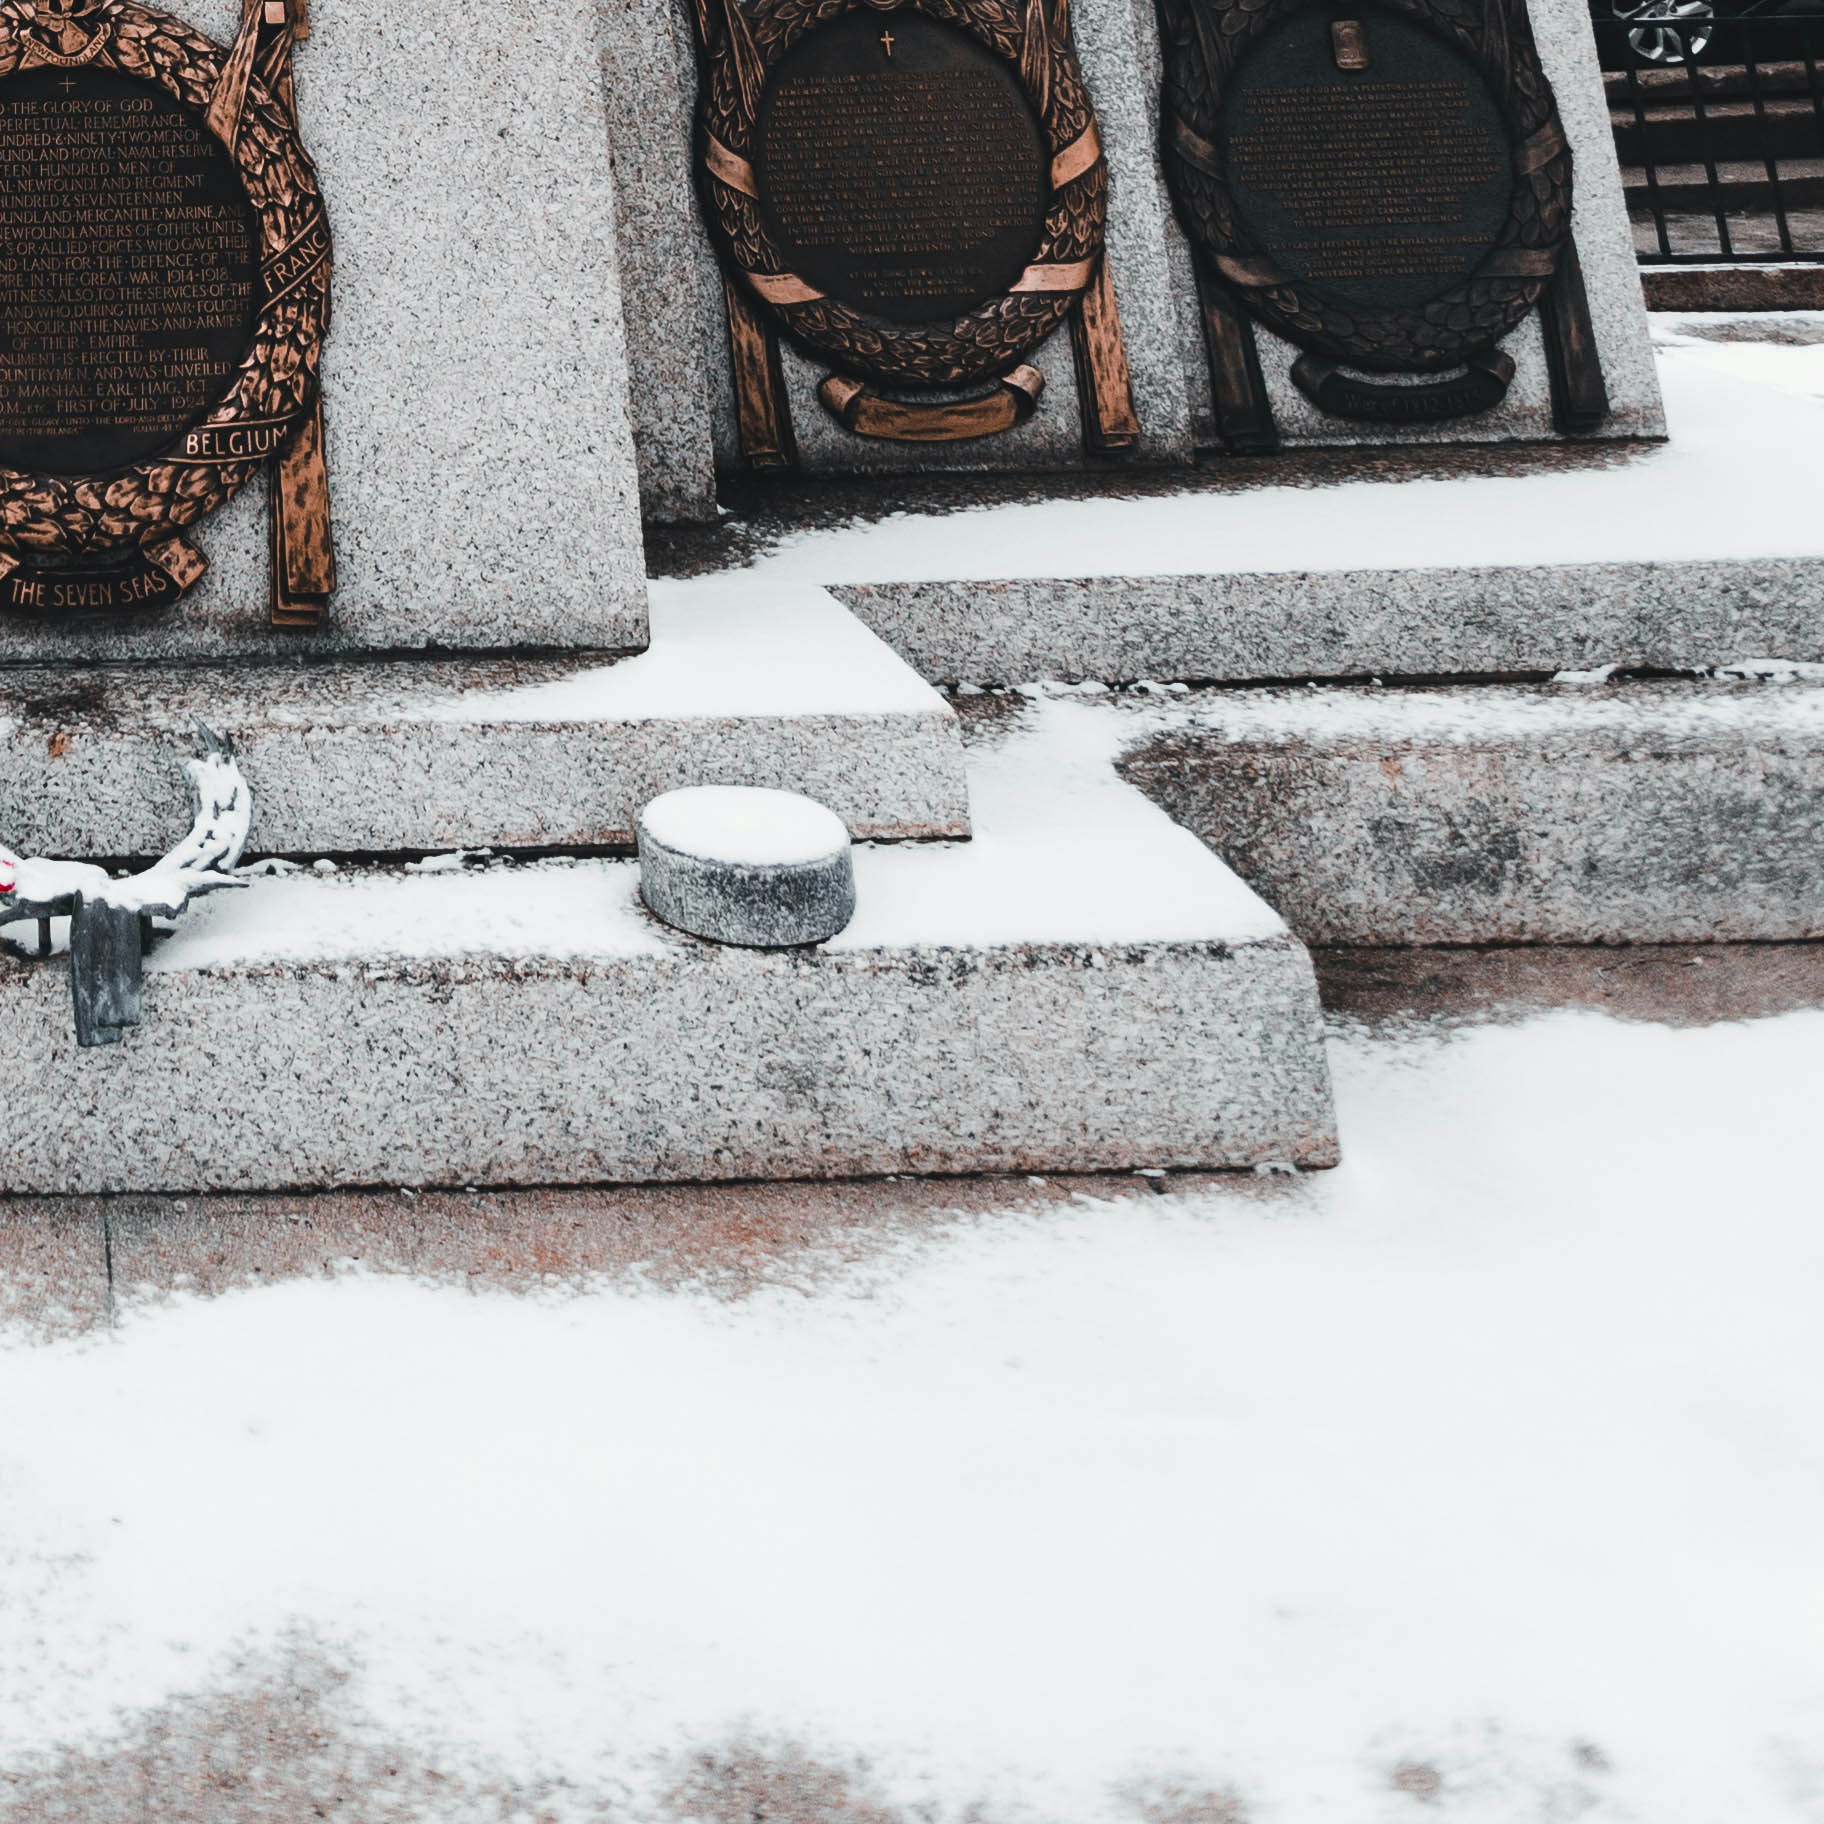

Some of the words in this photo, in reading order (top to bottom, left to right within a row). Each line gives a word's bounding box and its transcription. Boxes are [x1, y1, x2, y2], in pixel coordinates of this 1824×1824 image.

[24, 35, 107, 66] NEWFOUNDLAND
[11, 101, 35, 114] THE
[43, 100, 90, 114] GLORY
[94, 99, 111, 113] OF
[120, 98, 153, 112] GOD
[85, 113, 186, 129] REMEMBRANCE
[120, 130, 150, 144] TWO
[154, 129, 182, 143] MEN
[185, 129, 200, 142] OF
[73, 146, 113, 160] ROYAL
[118, 145, 158, 159] NAVAL
[40, 162, 109, 176] HUNDRED
[119, 161, 150, 174] MEN
[159, 160, 174, 174] OF
[17, 176, 131, 192] NEWFOUNDLAND
[136, 174, 204, 190] REGIMENT
[74, 191, 152, 206] SEVENTEEN
[156, 190, 183, 205] MEN
[76, 207, 159, 222] MERCANTILE
[136, 223, 152, 237] OF
[157, 222, 200, 236] OTHER
[205, 221, 245, 235] UNITS
[16, 241, 35, 255] OR
[40, 240, 87, 255] ALLIED
[92, 238, 143, 254] FORCES
[146, 238, 179, 252] WHO
[181, 237, 214, 252] GAVE
[23, 256, 61, 270] LAND
[65, 256, 91, 269] FOR
[96, 255, 123, 268] THE
[131, 253, 194, 268] DEFENCE
[201, 253, 217, 266] OF
[226, 252, 249, 265] THE
[263, 230, 327, 293] FRANC
[31, 272, 44, 286] IN
[49, 271, 74, 286] THE
[80, 270, 124, 285] GREAT
[98, 287, 115, 300] TO
[119, 286, 143, 300] THE
[147, 284, 206, 299] SERVICES
[209, 284, 225, 298] OF
[229, 283, 252, 297] THE
[74, 302, 124, 317] DURING
[127, 302, 159, 316] THAT
[197, 299, 250, 314] FOUGHT
[70, 319, 83, 333] IN
[86, 318, 110, 333] THE
[114, 317, 158, 332] NAVIES
[164, 316, 192, 331] AND
[196, 315, 242, 330] ARMIES
[12, 336, 31, 350] OF
[40, 335, 79, 350] THEIR
[63, 351, 76, 365] IS
[81, 349, 142, 364] ERECTED
[149, 349, 165, 363] BY
[171, 348, 208, 362] THEIR
[95, 365, 123, 379] AND
[127, 365, 158, 379] WAS
[164, 363, 231, 378] UNVEILED
[18, 382, 84, 398] MARSHAL
[96, 381, 133, 396] EARL
[57, 398, 94, 412] FIRST
[101, 397, 121, 411] OF
[128, 397, 159, 411] JULY
[186, 425, 288, 455] BELGIUM
[10, 578, 46, 607] THE
[54, 583, 112, 607] SEVEN
[120, 570, 167, 603] SEAS
